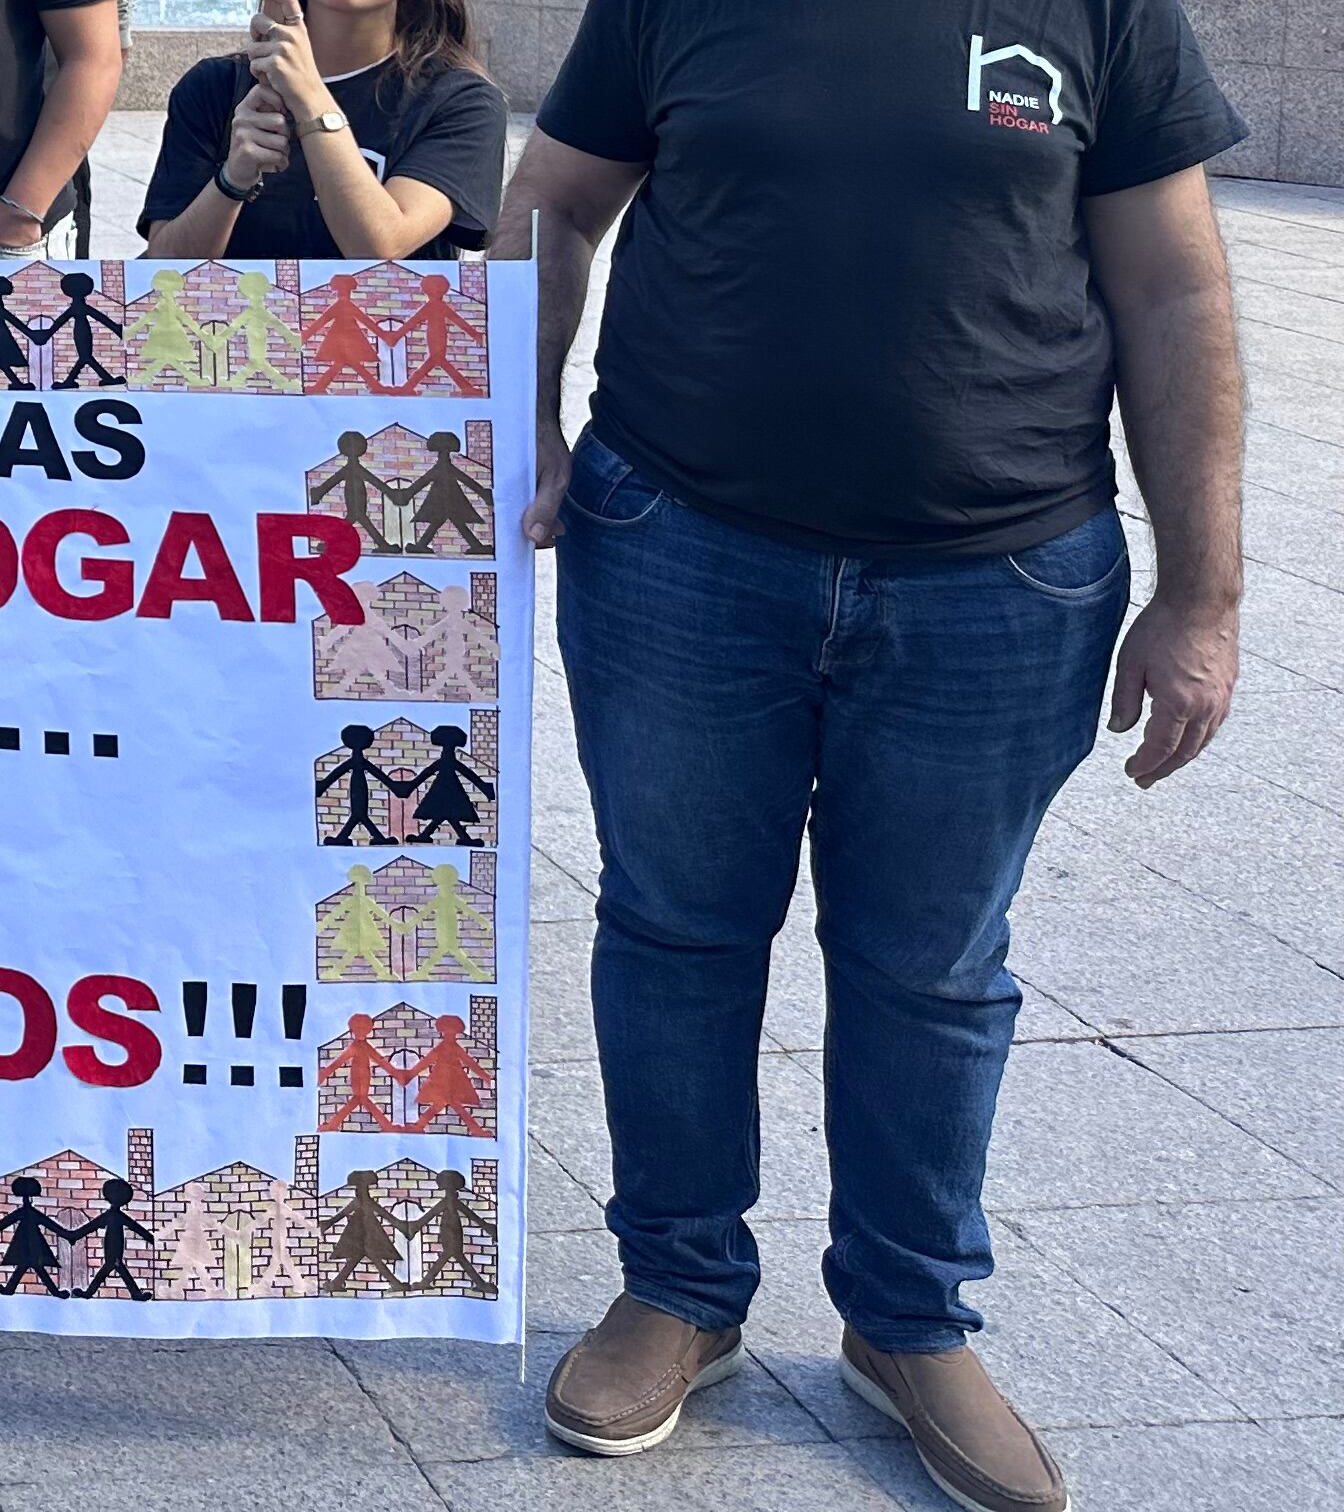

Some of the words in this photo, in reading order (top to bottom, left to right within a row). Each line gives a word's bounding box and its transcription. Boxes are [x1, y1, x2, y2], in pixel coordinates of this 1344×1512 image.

[989, 90, 1040, 110] NADIE
[989, 102, 1018, 117] SIN
[989, 114, 1049, 134] HOGAR
